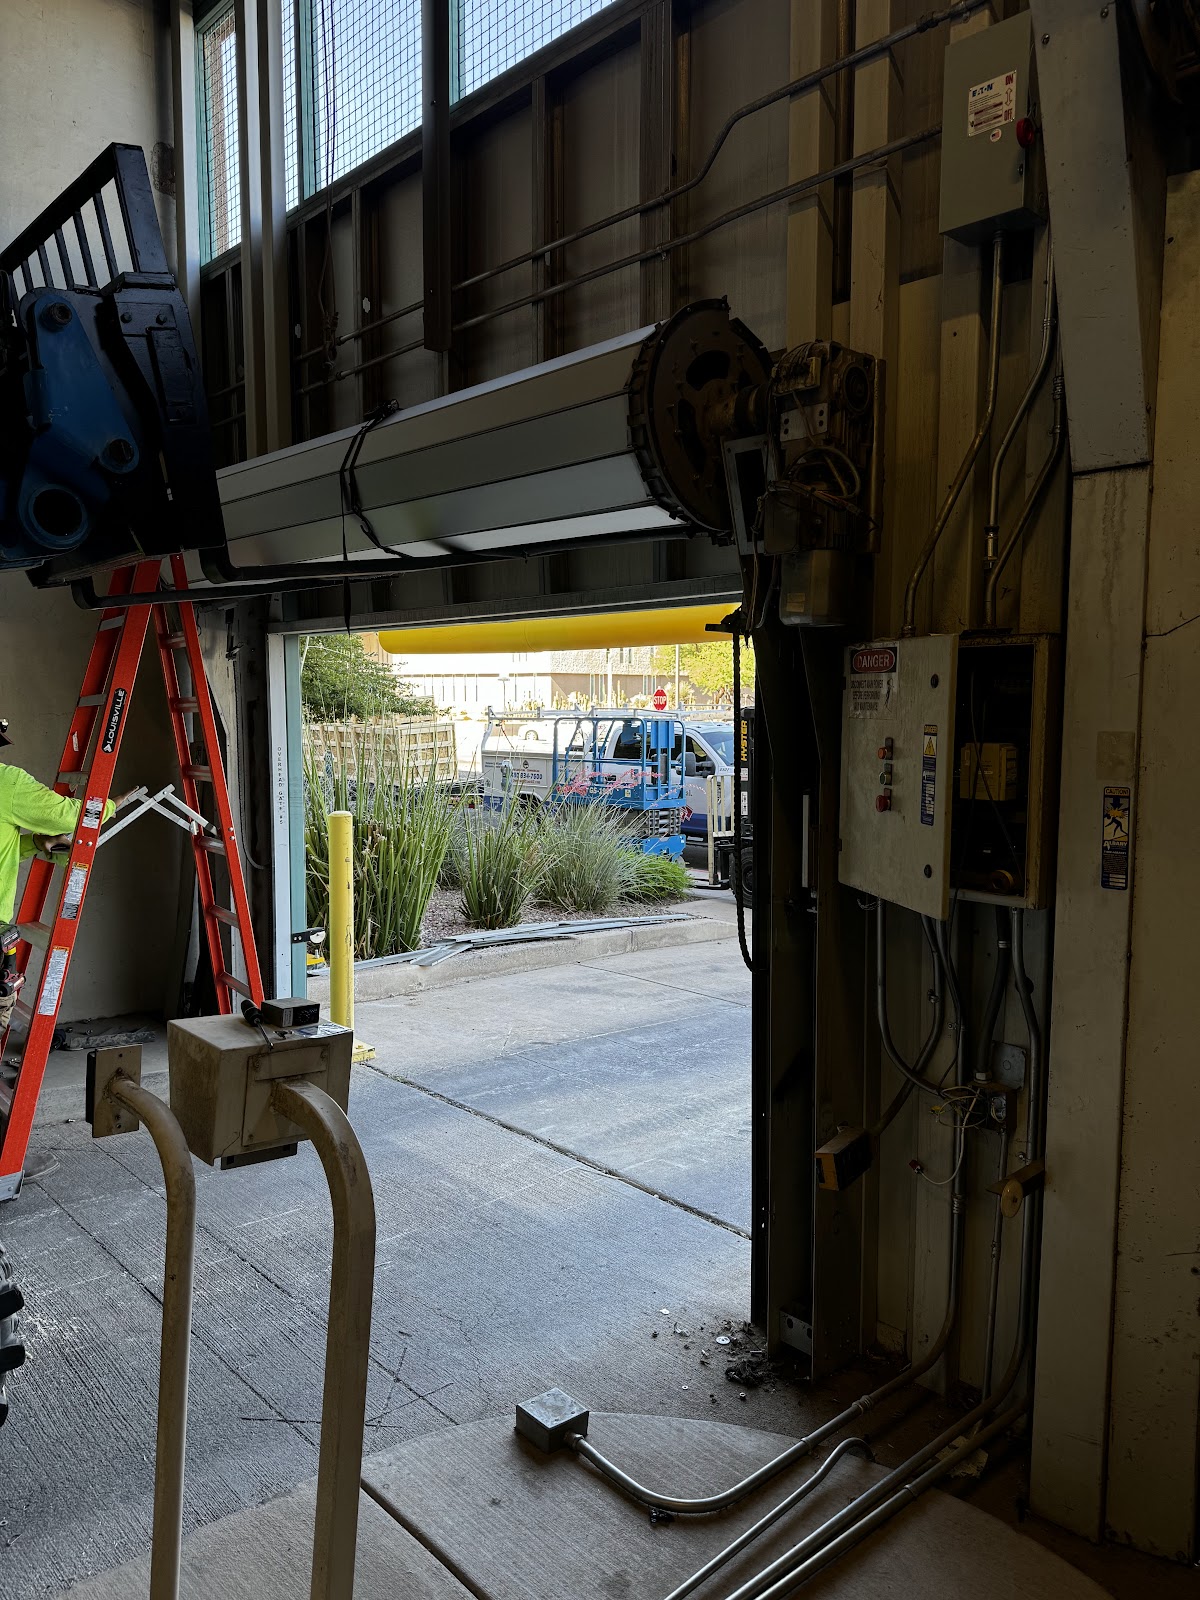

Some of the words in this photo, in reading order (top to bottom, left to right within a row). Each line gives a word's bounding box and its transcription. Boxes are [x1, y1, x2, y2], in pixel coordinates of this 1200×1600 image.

[1005, 73, 1014, 86] ON
[1004, 108, 1013, 122] OFF
[857, 654, 890, 668] DANGER
[653, 695, 667, 705] STOP
[106, 689, 125, 744] LOUISVILLE
[740, 720, 748, 761] HYSTER
[1103, 840, 1128, 850] ALBANY
